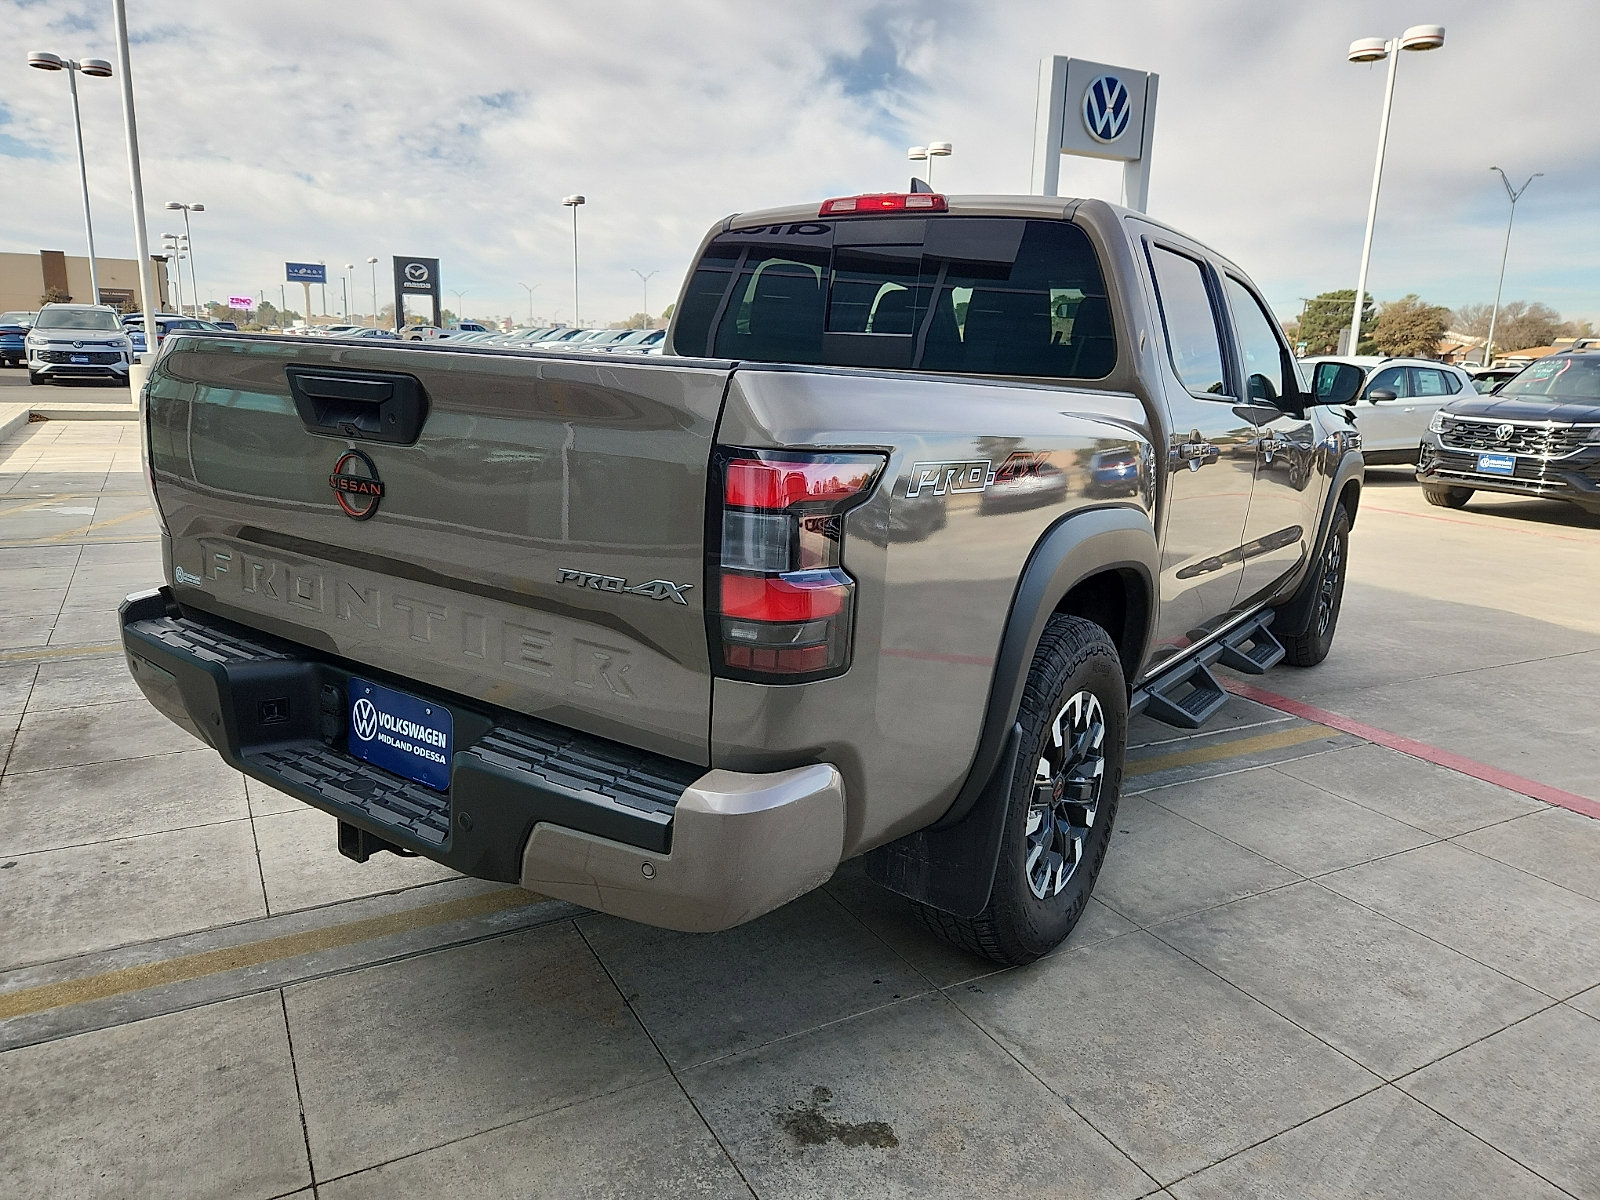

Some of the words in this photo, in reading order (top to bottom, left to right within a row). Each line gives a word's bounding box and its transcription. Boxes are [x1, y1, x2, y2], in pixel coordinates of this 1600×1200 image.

[329, 475, 381, 495] NISSAN
[905, 451, 1051, 498] PRO-4X
[556, 566, 694, 605] PRO-4X
[200, 541, 638, 700] FRONTIER
[378, 710, 447, 748] VOLKSWAGEN
[377, 732, 413, 752] MIDLAND
[413, 746, 446, 765] ODESSA
